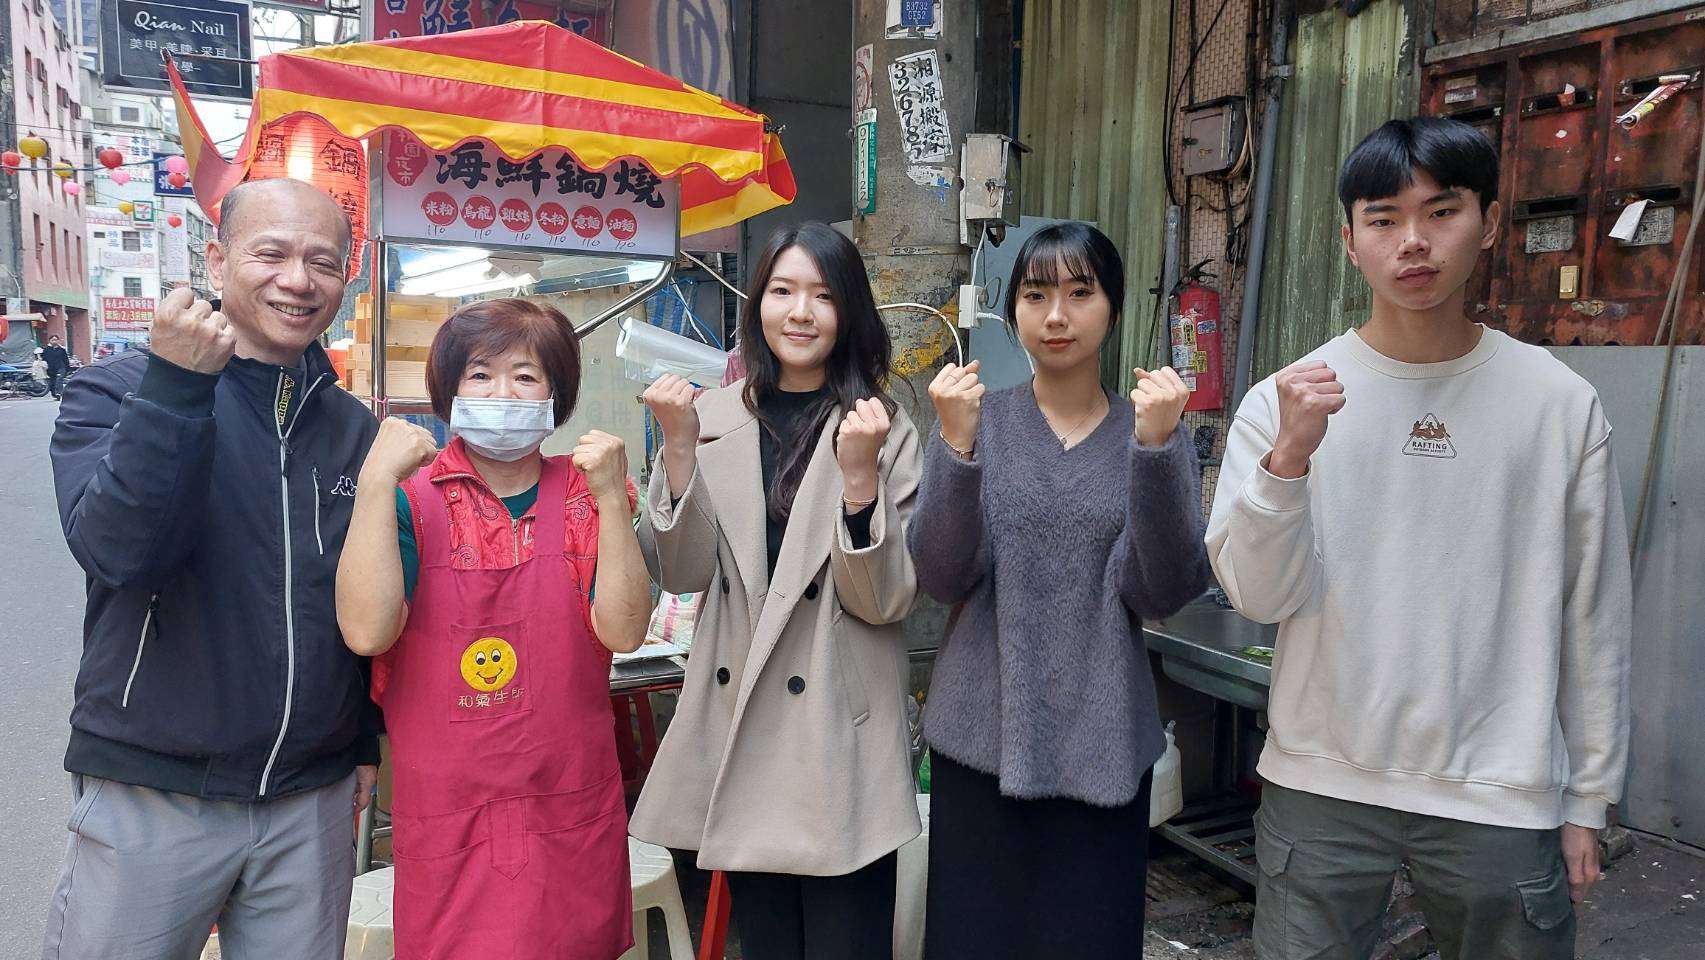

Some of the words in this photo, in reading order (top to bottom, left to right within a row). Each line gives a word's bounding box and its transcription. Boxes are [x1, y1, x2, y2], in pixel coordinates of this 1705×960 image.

[906, 1, 928, 11] B3732
[134, 10, 187, 31] Qian
[190, 19, 225, 36] Nail
[894, 62, 922, 159] 326785
[435, 141, 665, 209] 海鮮鍋燒
[426, 201, 455, 216] 米粉
[464, 204, 493, 221] 烏龍
[537, 212, 565, 226] 冬粉
[475, 229, 492, 239] 110
[1412, 441, 1447, 450] RAFTING
